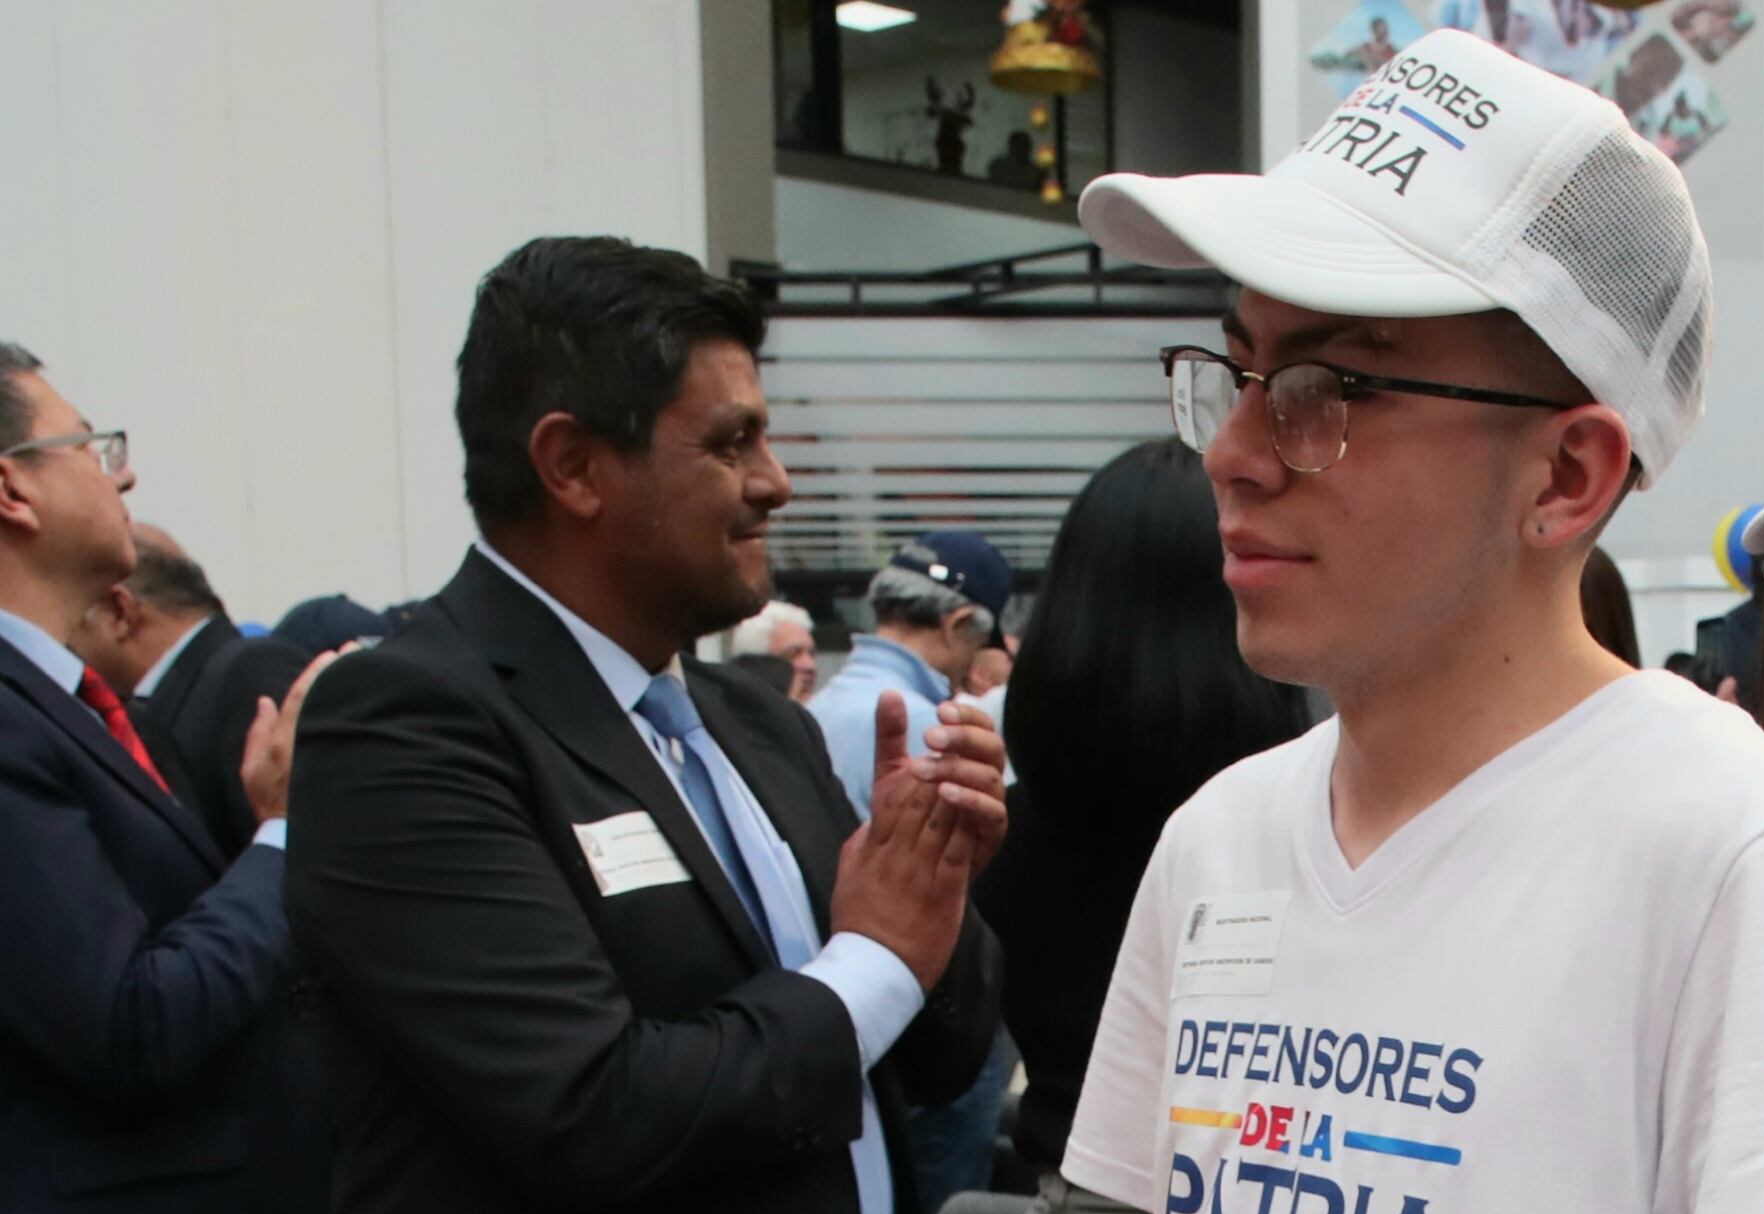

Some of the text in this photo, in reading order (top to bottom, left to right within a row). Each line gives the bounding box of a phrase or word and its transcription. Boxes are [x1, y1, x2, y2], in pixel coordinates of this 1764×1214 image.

[1365, 57, 1499, 130] NSORES
[1366, 88, 1399, 114] LA
[1296, 115, 1428, 196] TRIA
[1175, 1020, 1484, 1114] DEFENSORES
[1239, 1102, 1332, 1162] DE LA
